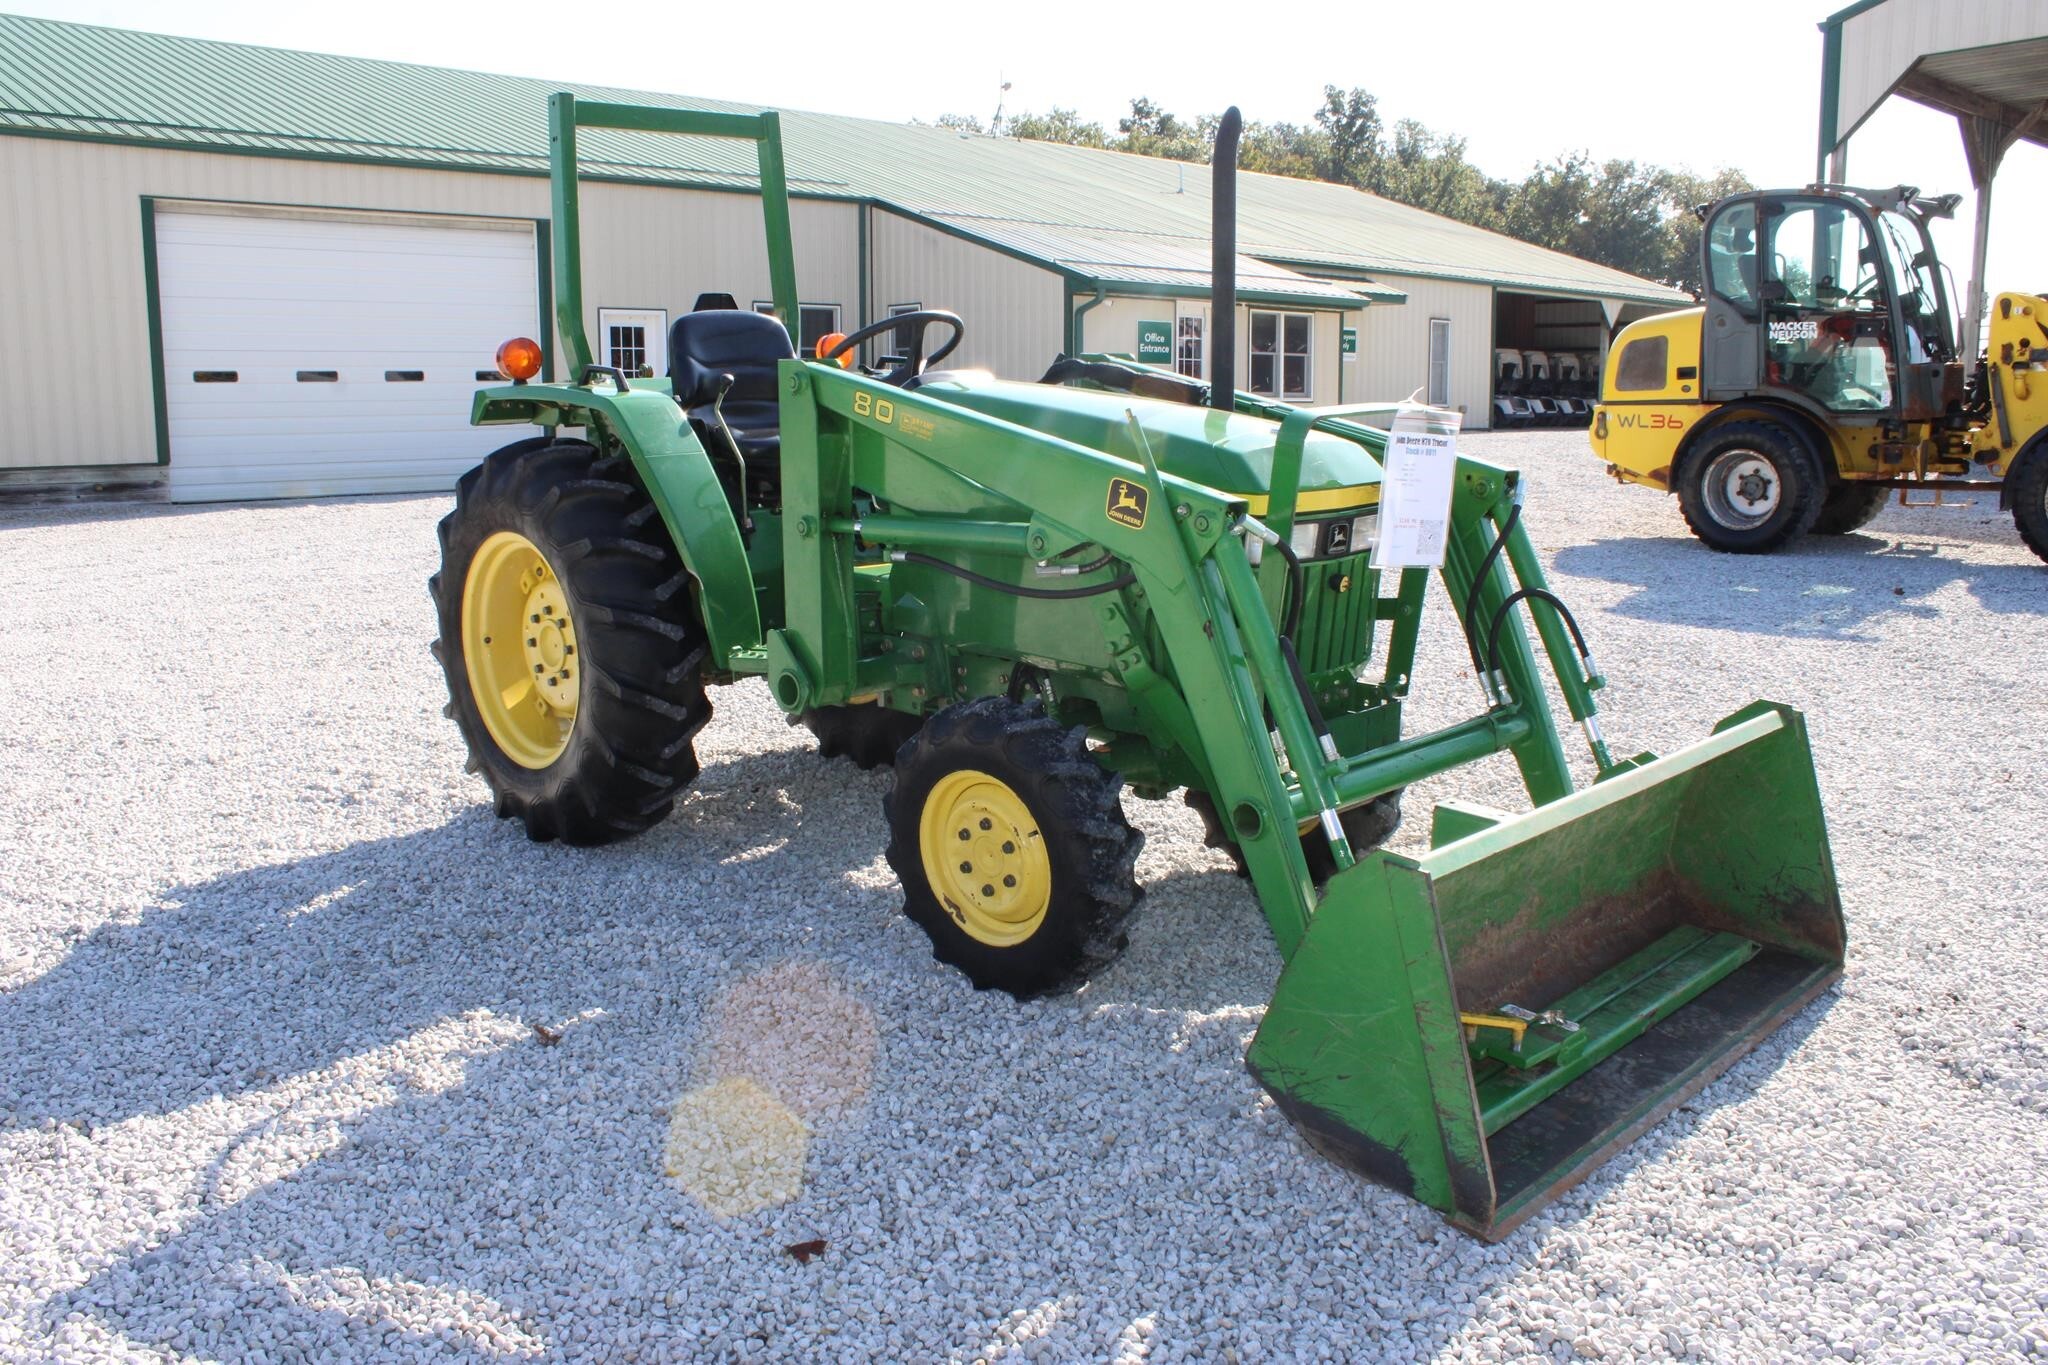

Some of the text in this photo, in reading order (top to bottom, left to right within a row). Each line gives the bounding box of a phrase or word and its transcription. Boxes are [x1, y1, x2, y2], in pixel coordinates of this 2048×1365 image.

[1769, 321, 1817, 330] WACKER
[1144, 332, 1165, 343] Office
[1769, 330, 1818, 339] NEUSON
[1140, 343, 1170, 353] Entrance
[854, 391, 894, 424] 80
[1617, 414, 1684, 429] WL36
[1109, 510, 1142, 526] JOHN DEERE
